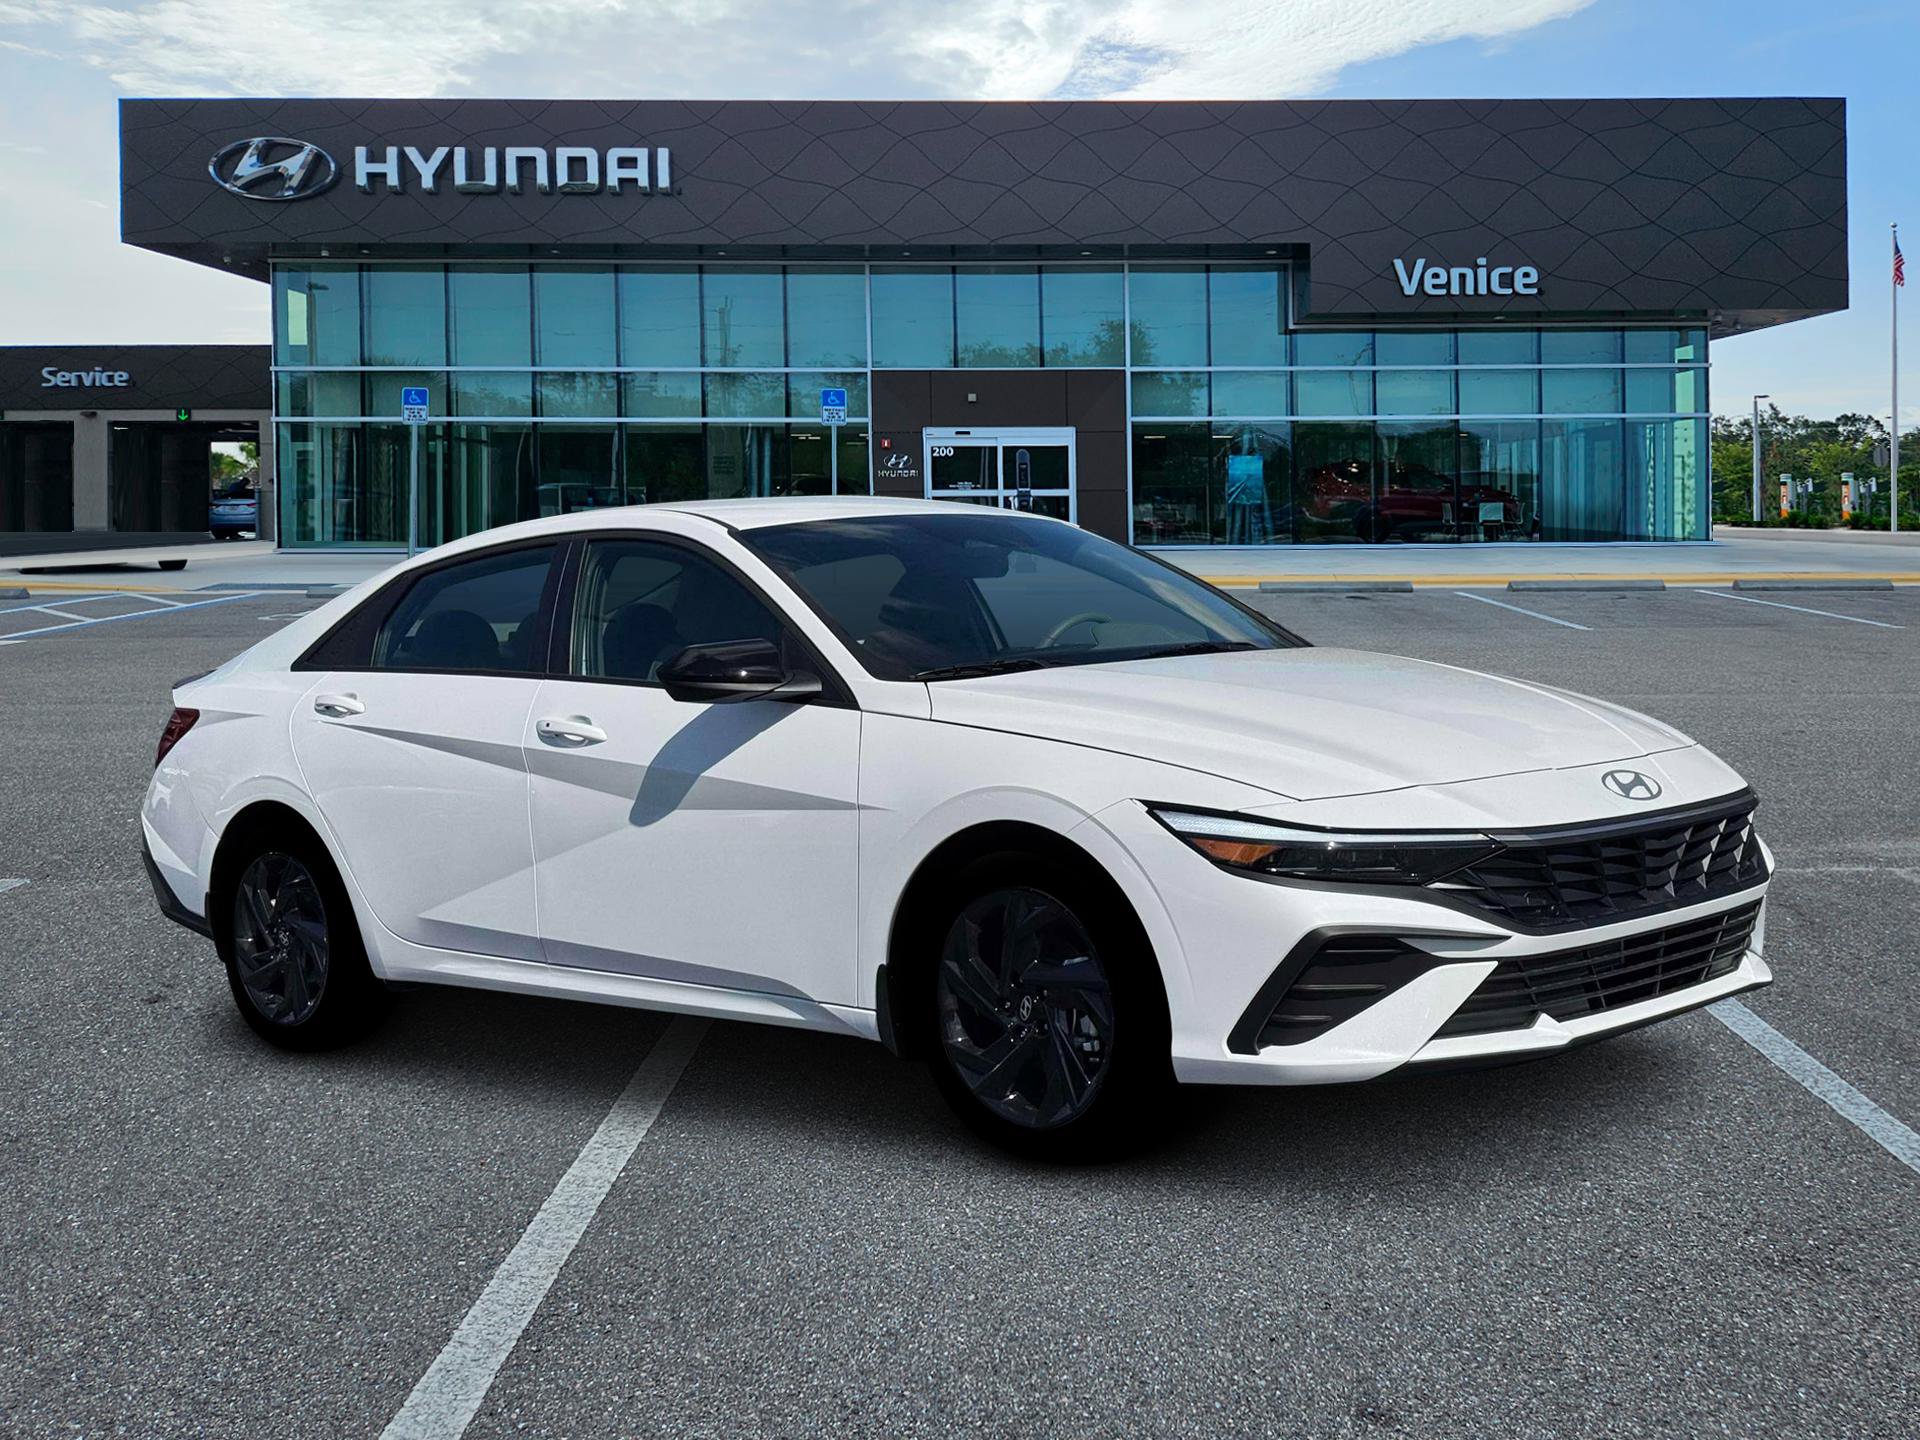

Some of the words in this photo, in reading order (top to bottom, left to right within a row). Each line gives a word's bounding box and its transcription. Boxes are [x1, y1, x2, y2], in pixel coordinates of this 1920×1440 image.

[354, 146, 671, 194] HYUNDAI
[1393, 257, 1539, 296] Venice
[41, 366, 129, 387] Service
[932, 447, 954, 457] 200
[878, 470, 919, 478] HYUNDAI
